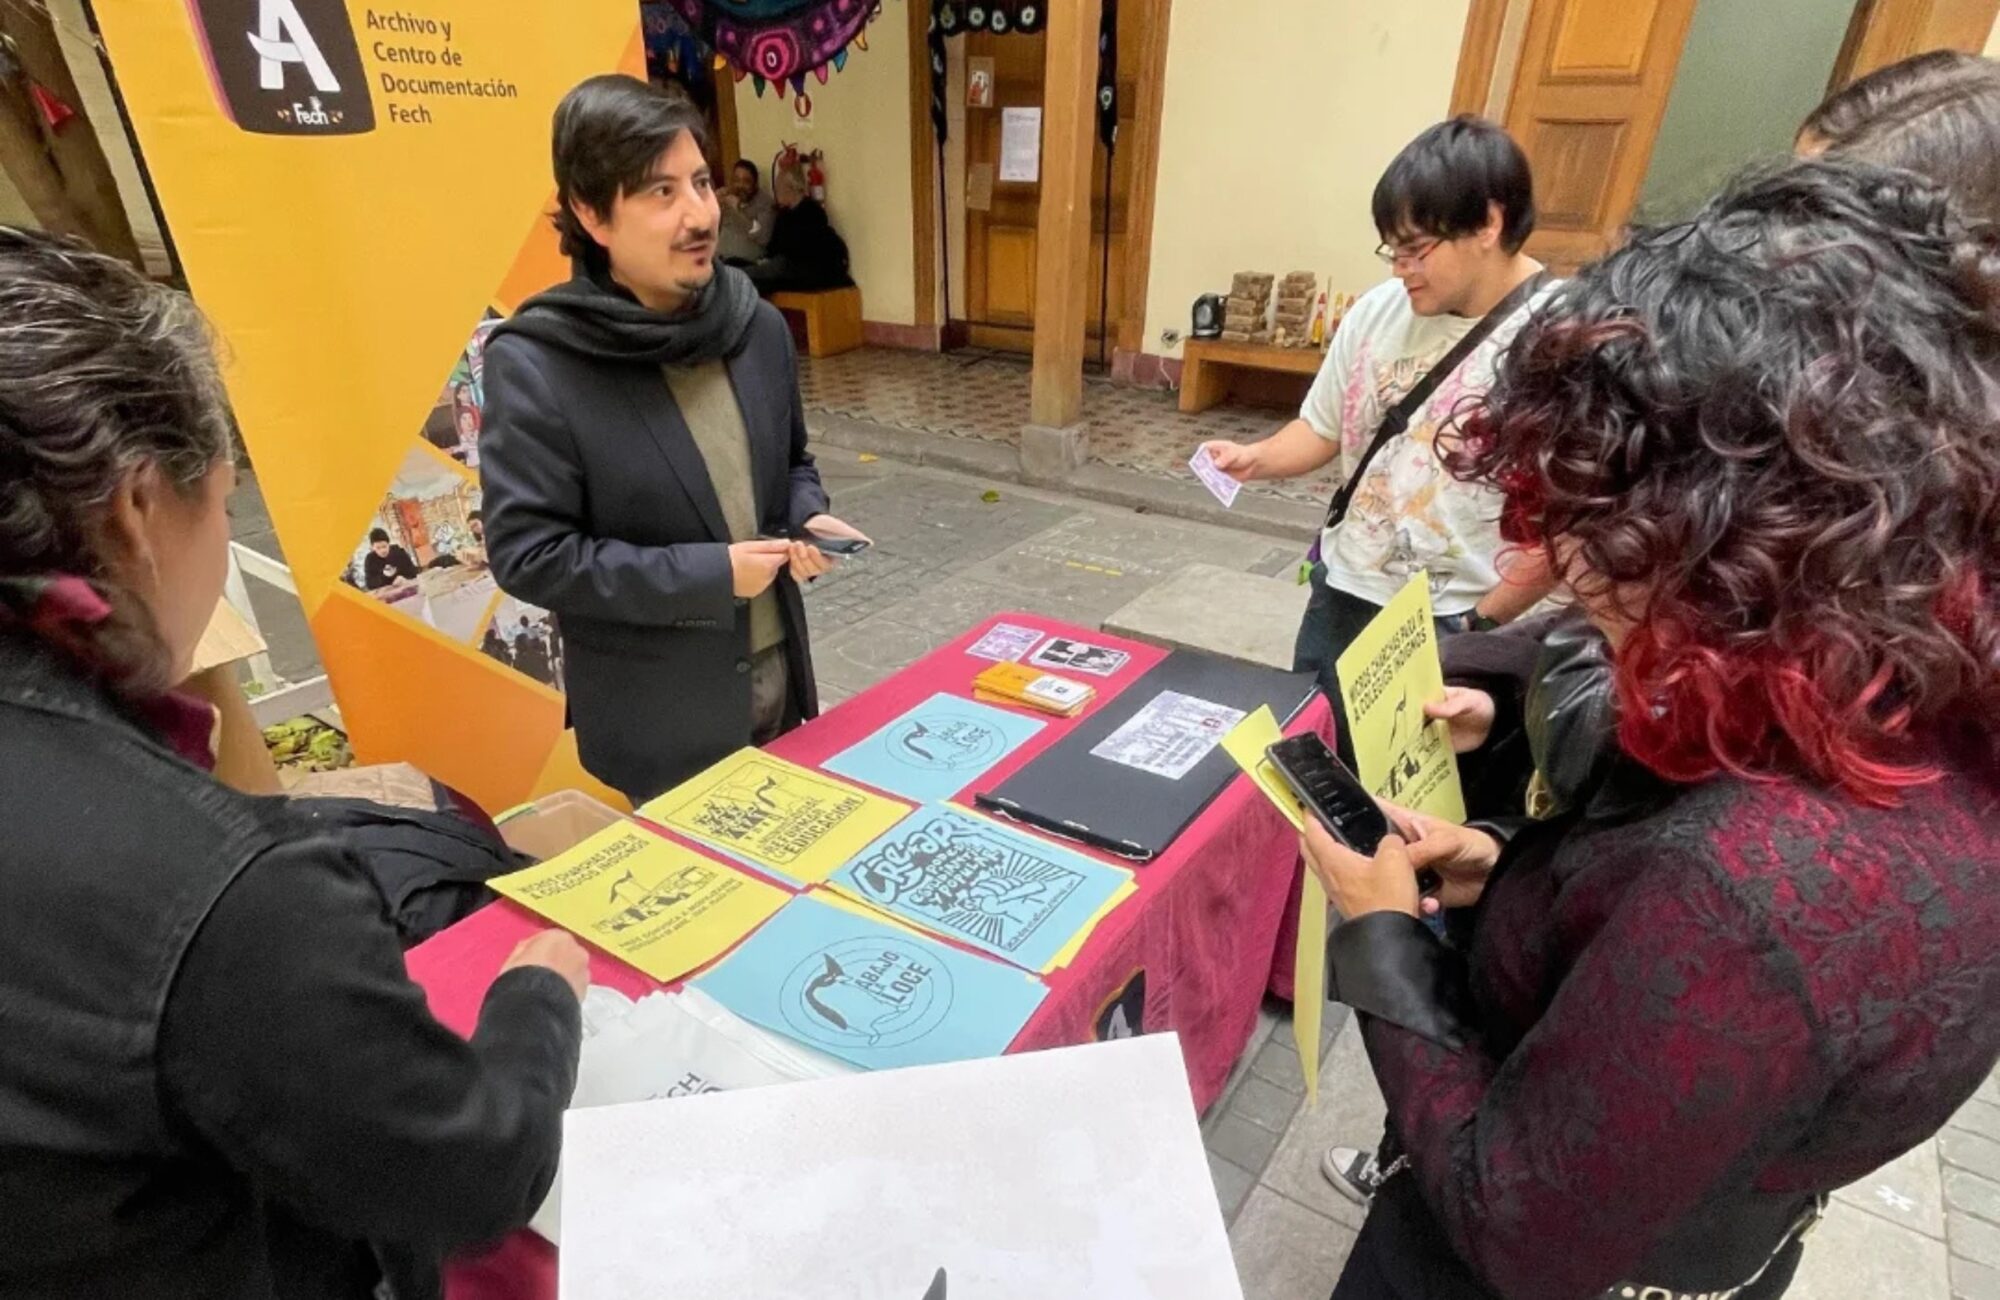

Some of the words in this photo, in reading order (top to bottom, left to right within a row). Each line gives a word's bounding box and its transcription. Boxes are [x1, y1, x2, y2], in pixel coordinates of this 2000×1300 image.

[367, 9, 437, 34] Archivo
[441, 21, 451, 41] y
[374, 42, 436, 65] Centro
[441, 48, 462, 66] de
[381, 73, 517, 97] Documentación
[292, 96, 329, 125] Fech
[388, 103, 432, 123] Fech
[783, 795, 861, 855] EDUCACIÓN
[855, 951, 900, 990] ABAJO
[880, 962, 932, 1004] LOCE
